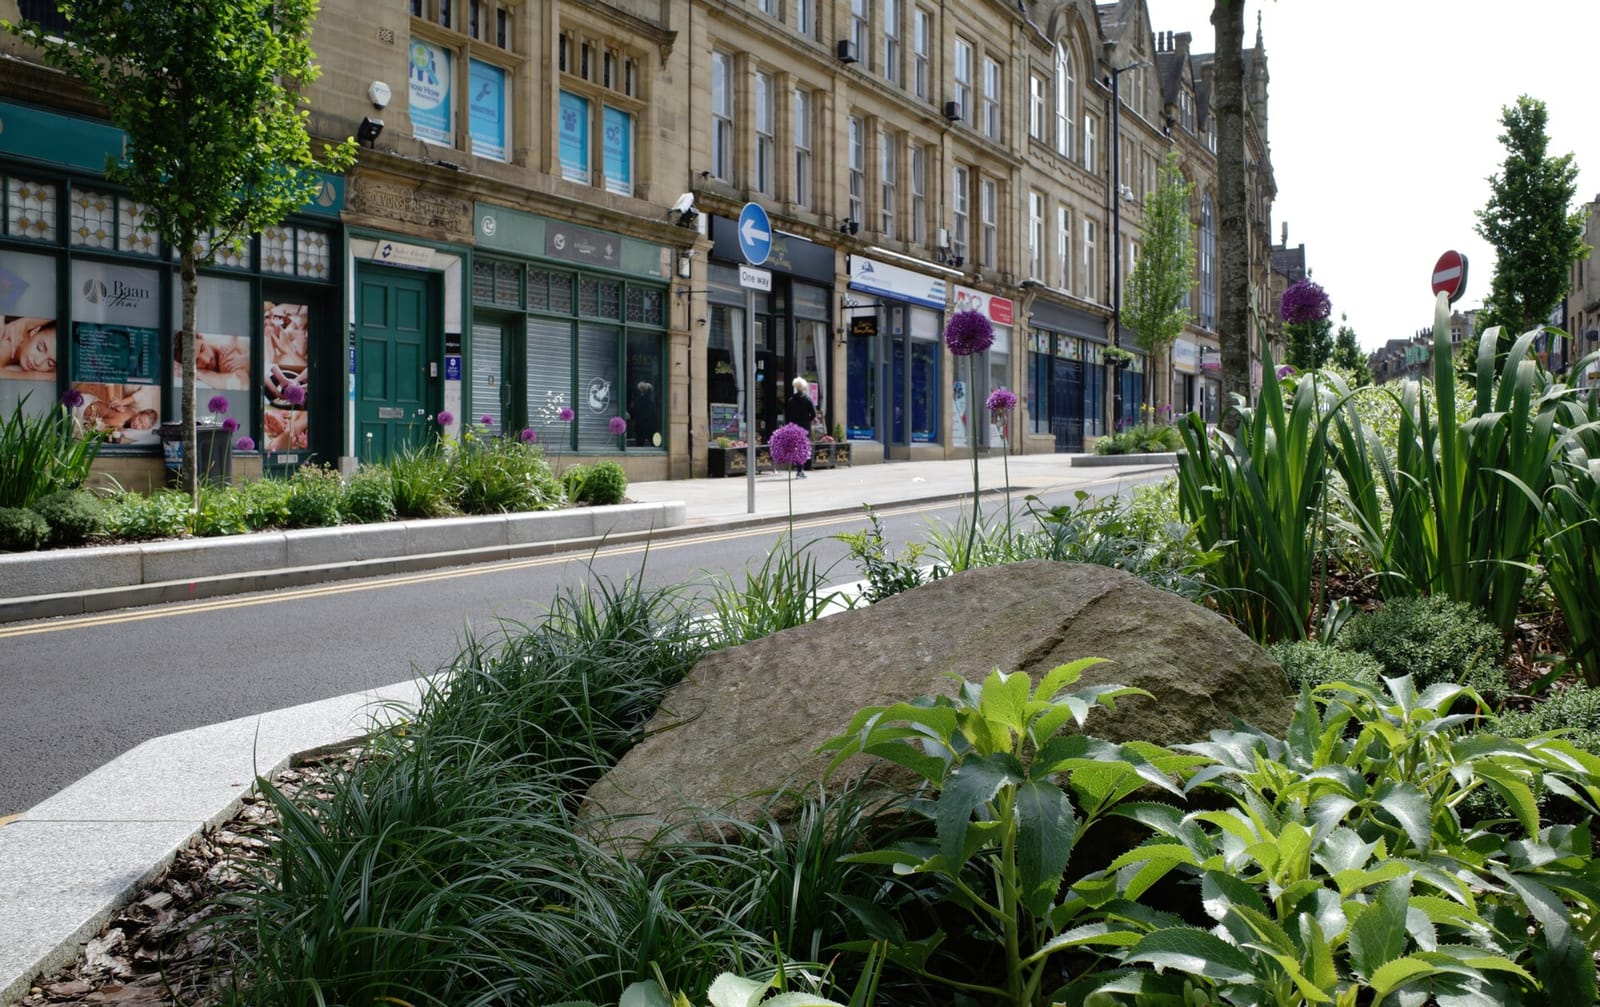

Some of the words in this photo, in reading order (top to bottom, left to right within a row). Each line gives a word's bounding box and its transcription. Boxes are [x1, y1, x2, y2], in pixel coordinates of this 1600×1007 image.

[423, 87, 440, 98] How
[743, 271, 755, 283] One
[756, 276, 769, 287] way
[113, 280, 149, 299] Baan
